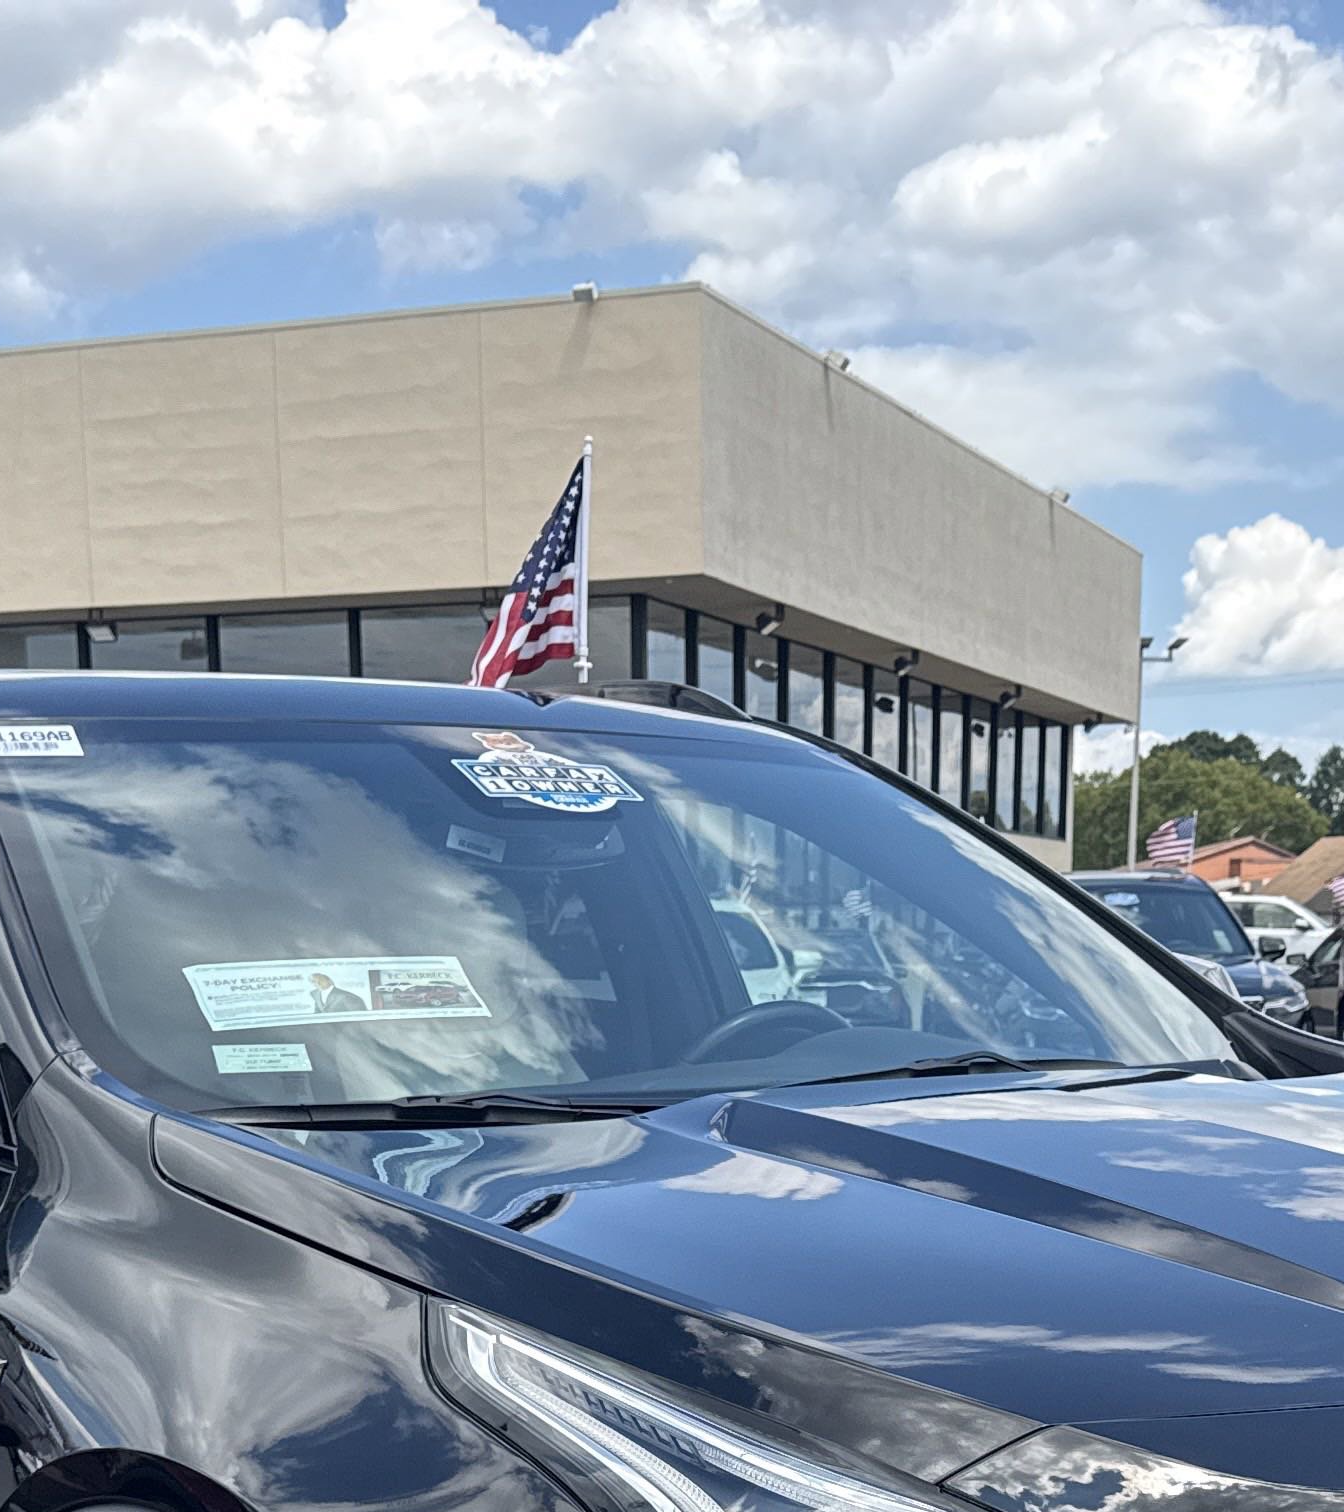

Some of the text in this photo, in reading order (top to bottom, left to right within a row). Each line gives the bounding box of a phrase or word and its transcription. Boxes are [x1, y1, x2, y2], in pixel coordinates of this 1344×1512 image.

[472, 764, 613, 782] CARFAX
[487, 778, 627, 795] 1 OWNER
